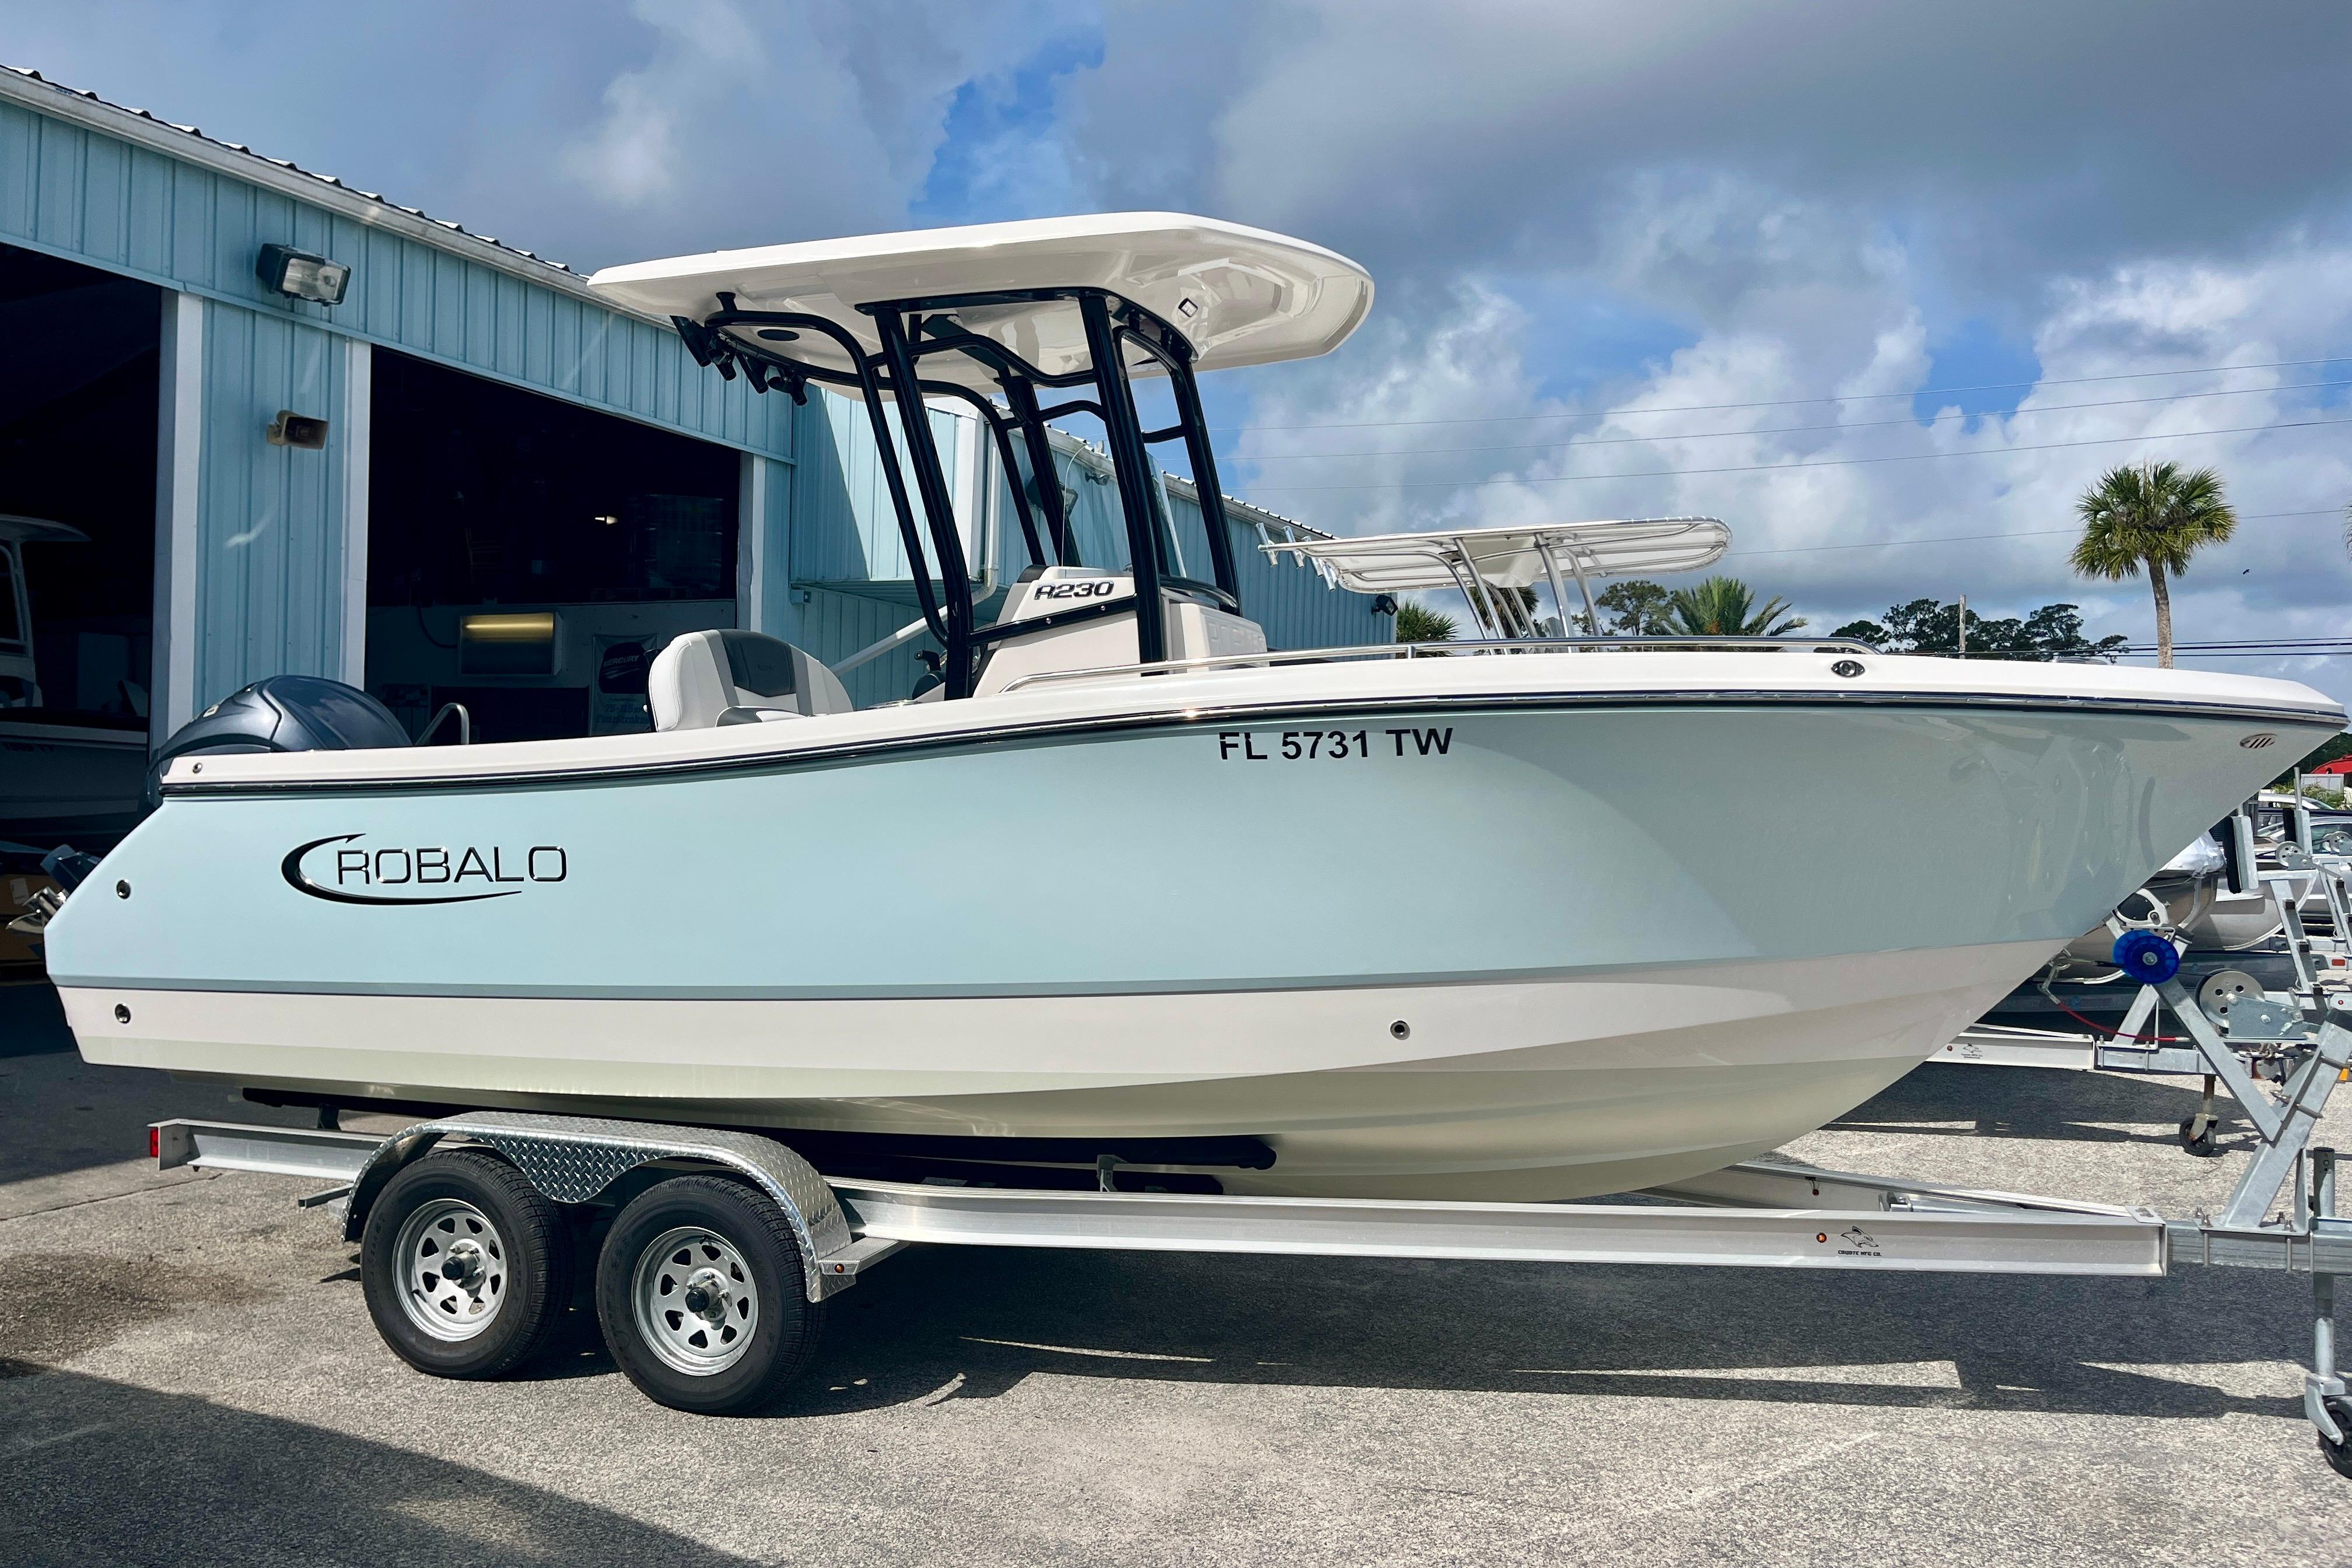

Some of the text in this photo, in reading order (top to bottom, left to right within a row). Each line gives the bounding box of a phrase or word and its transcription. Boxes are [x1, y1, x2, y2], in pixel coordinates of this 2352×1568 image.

[1034, 580, 1115, 600] R230
[603, 654, 640, 668] MERCURY
[1219, 727, 1453, 760] FL 5731 TW
[337, 845, 568, 885] ROBALO
